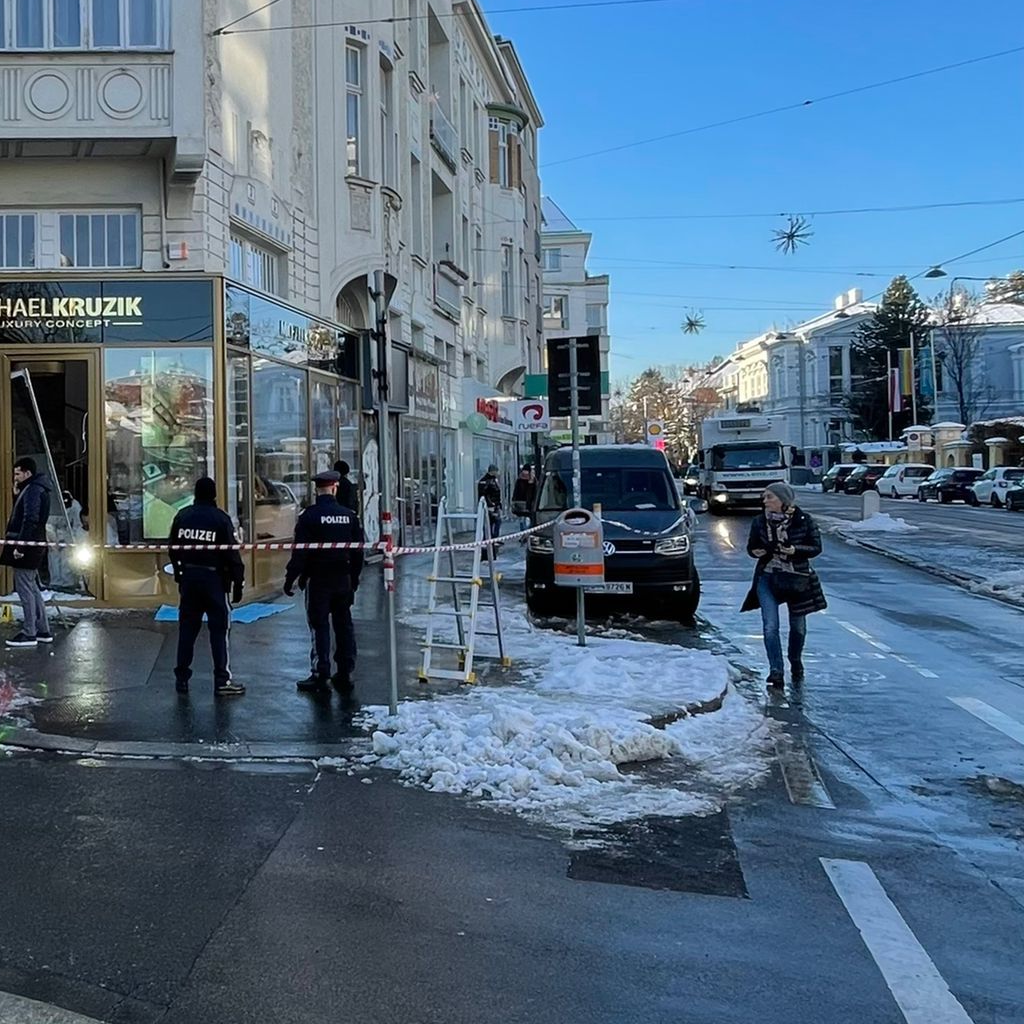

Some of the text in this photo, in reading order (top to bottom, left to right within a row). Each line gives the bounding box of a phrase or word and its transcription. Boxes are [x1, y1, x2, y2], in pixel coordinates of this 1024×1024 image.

[45, 319, 111, 328] CONCEPT
[321, 515, 350, 524] POLIZEI
[178, 528, 217, 542] POLIZEI
